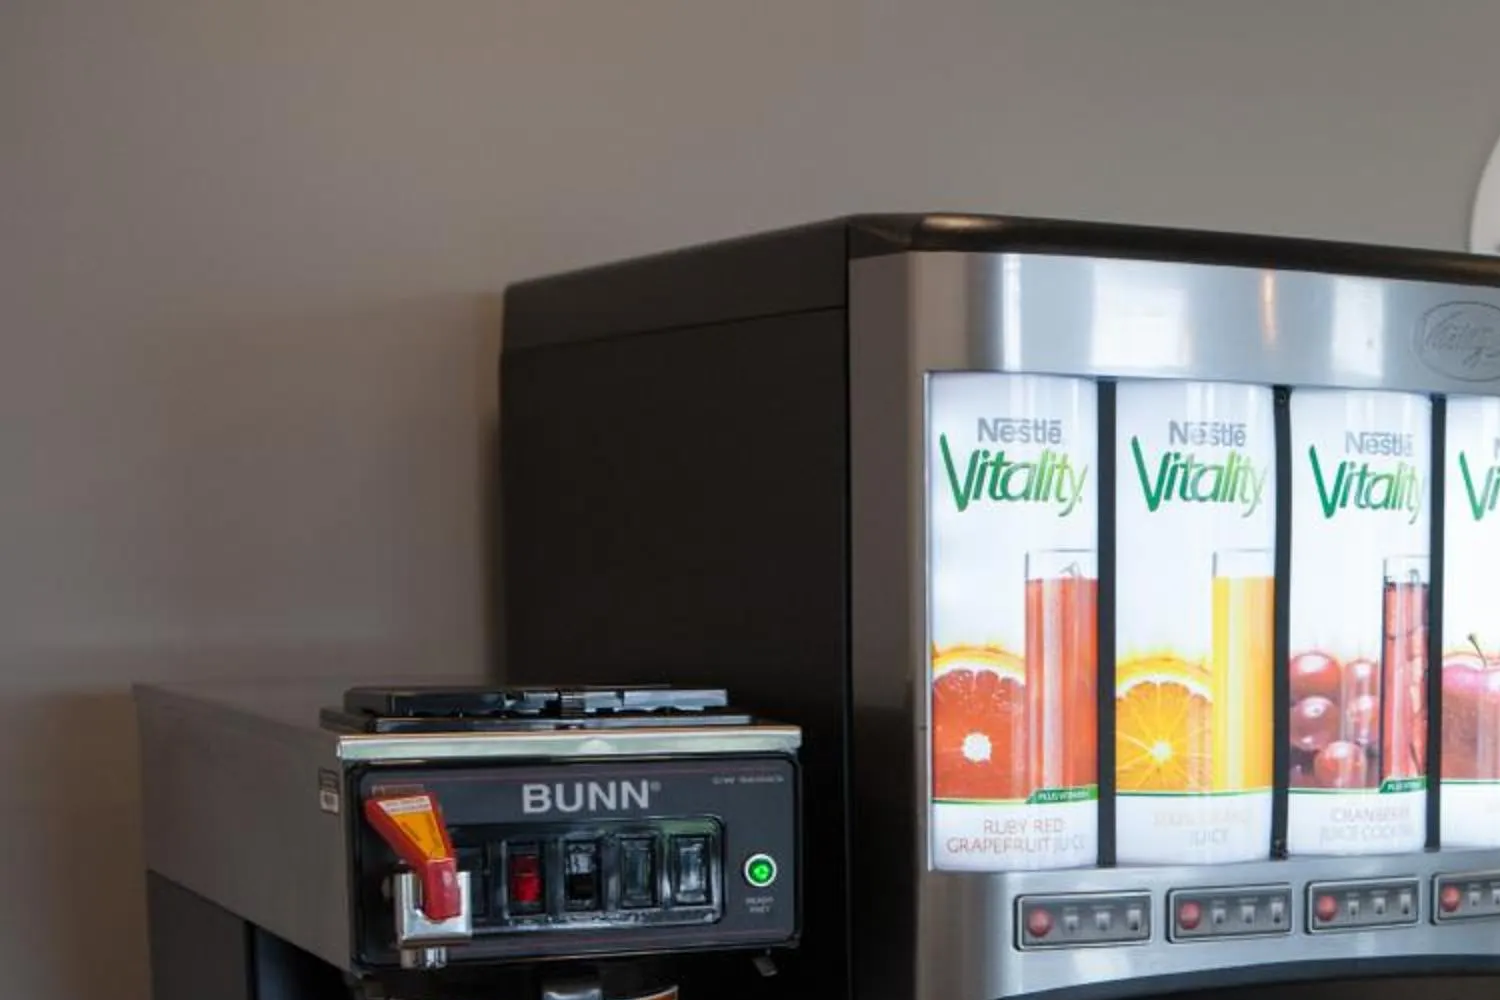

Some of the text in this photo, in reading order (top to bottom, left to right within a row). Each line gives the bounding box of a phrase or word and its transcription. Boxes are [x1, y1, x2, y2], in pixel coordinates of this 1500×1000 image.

[939, 431, 1088, 518] Vitality
[1131, 435, 1267, 518] Vitality
[946, 835, 1051, 854] GRAPEFRUIT
[983, 817, 1065, 835] RUBY RED
